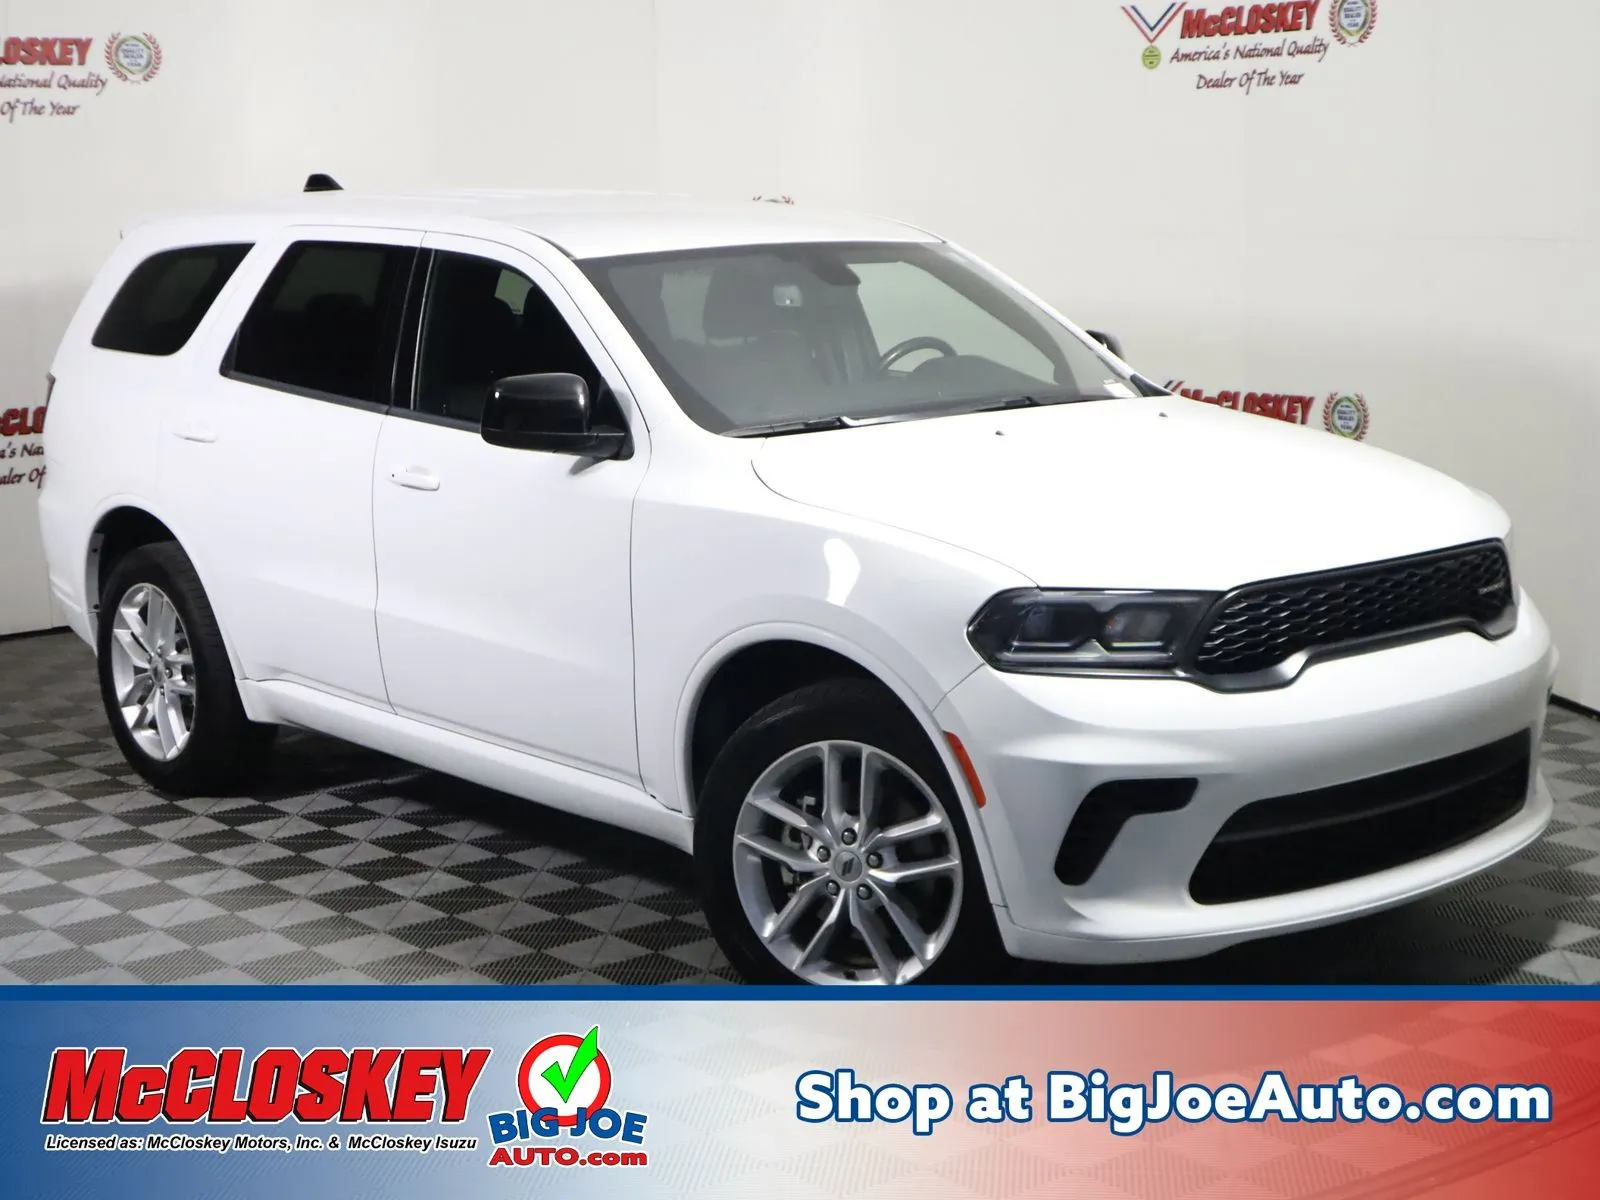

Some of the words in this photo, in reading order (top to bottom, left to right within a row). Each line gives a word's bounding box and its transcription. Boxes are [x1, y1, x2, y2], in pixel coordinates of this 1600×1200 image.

[1180, 0, 1320, 39] McCLOSKEY
[0, 37, 93, 66] OSKEY
[1169, 42, 1230, 64] America's
[1233, 37, 1287, 60] National
[1287, 36, 1329, 63] Quality
[57, 71, 108, 96] Quality
[1196, 71, 1237, 90] Dealer
[1238, 69, 1257, 96] Of
[1256, 68, 1276, 87] The
[1279, 70, 1305, 86] Year
[0, 98, 20, 124] Of
[20, 98, 45, 116] The
[49, 101, 81, 116] Year
